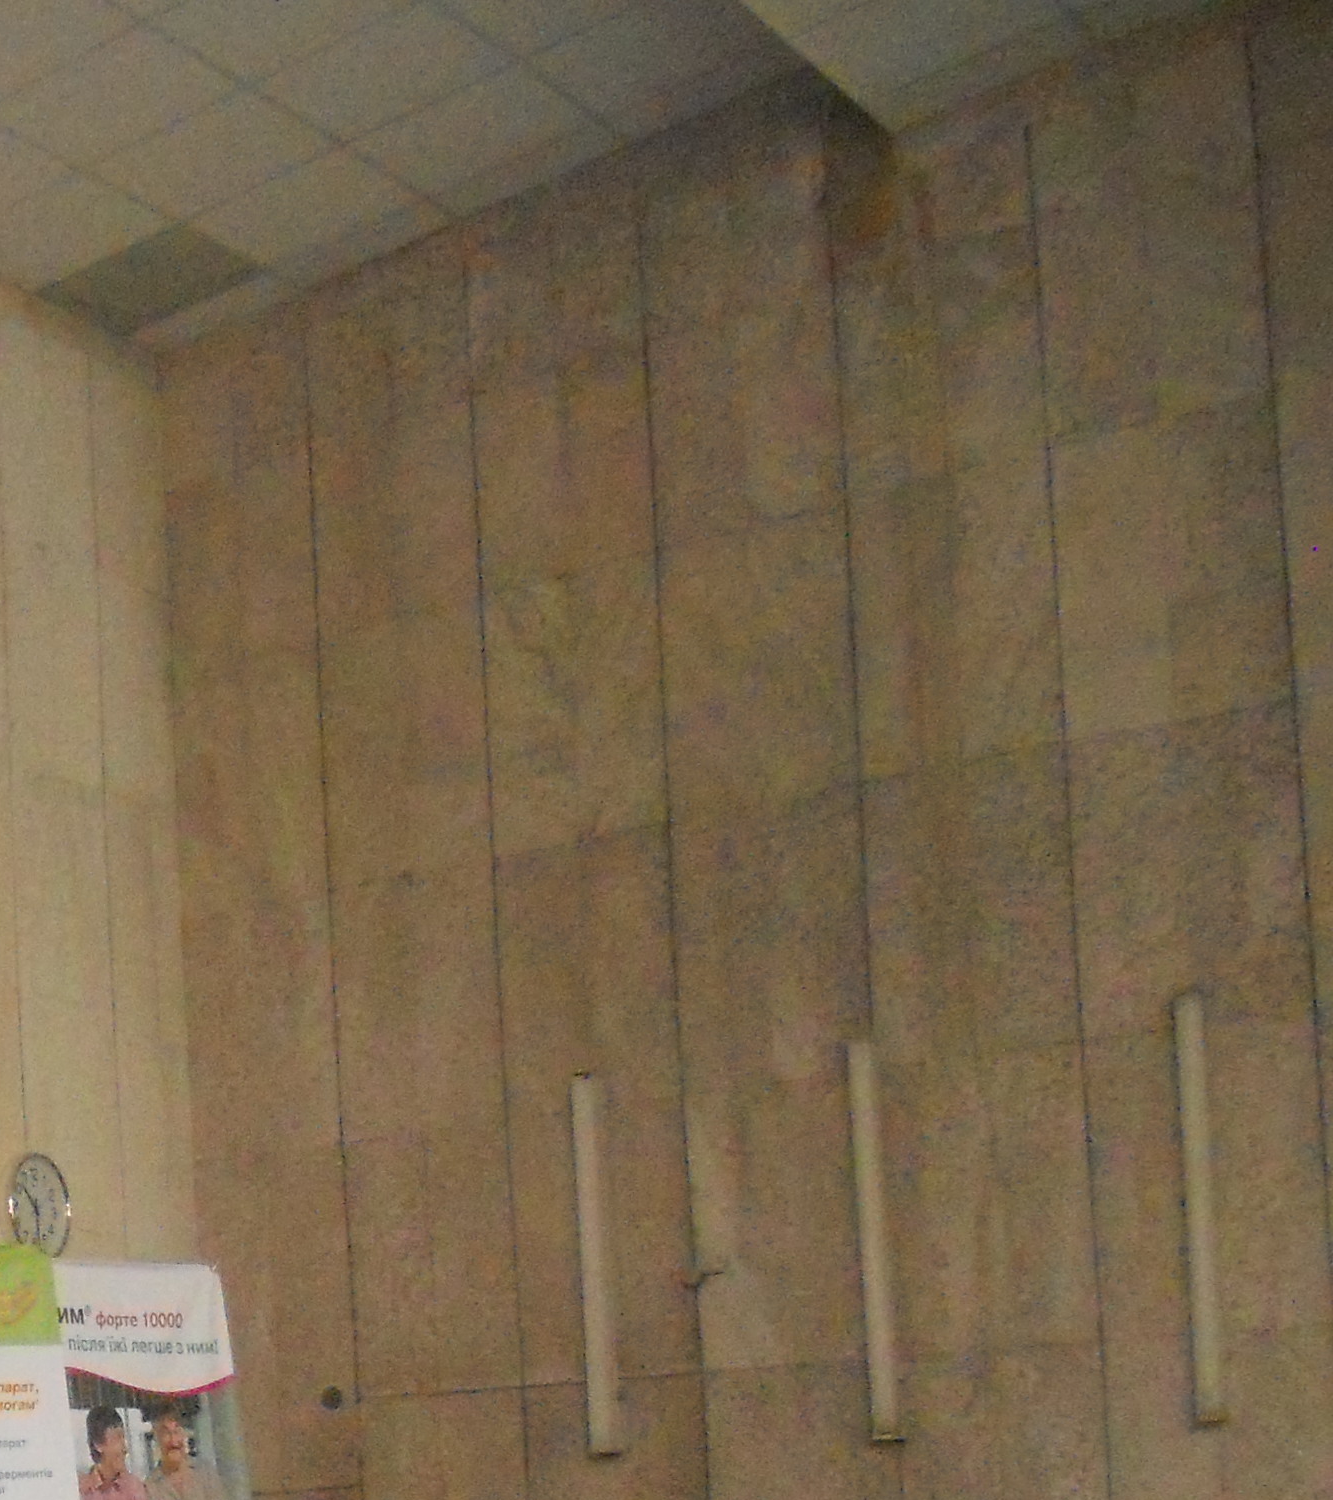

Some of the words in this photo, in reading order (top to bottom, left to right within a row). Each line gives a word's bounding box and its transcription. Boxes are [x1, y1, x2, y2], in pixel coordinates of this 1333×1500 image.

[95, 1311, 138, 1330] форте
[143, 1312, 184, 1329] 10000
[68, 1336, 106, 1352] після
[131, 1340, 173, 1355] легше
